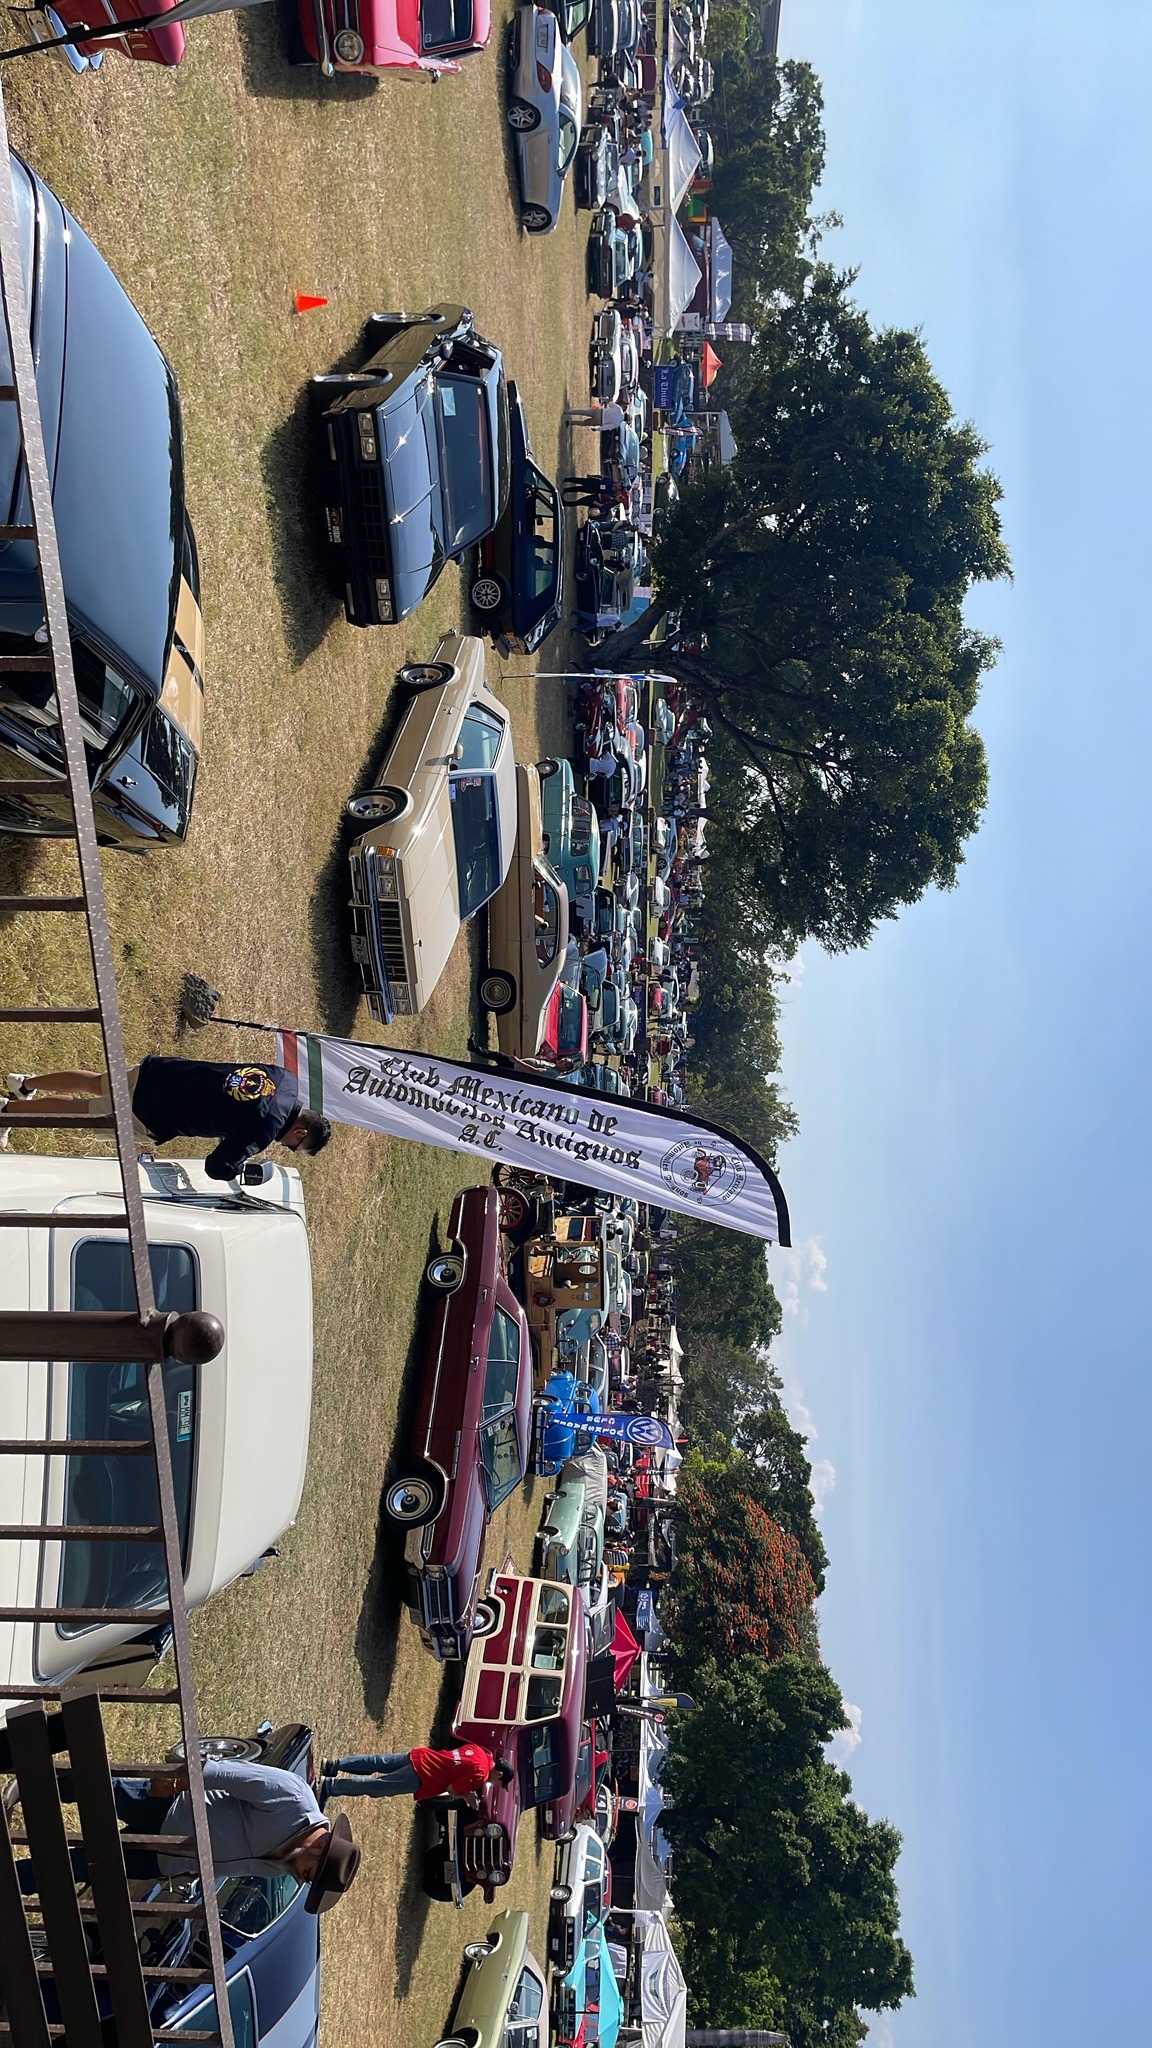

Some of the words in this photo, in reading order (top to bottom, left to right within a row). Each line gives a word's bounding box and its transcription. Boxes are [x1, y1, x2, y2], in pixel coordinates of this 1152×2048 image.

[661, 368, 669, 380] La
[661, 381, 669, 407] Unión
[378, 1057, 440, 1088] Club
[446, 1076, 581, 1125] Mexicano
[588, 1110, 618, 1137] de
[514, 1120, 642, 1169] Antiguos
[586, 1416, 615, 1424] CLUB
